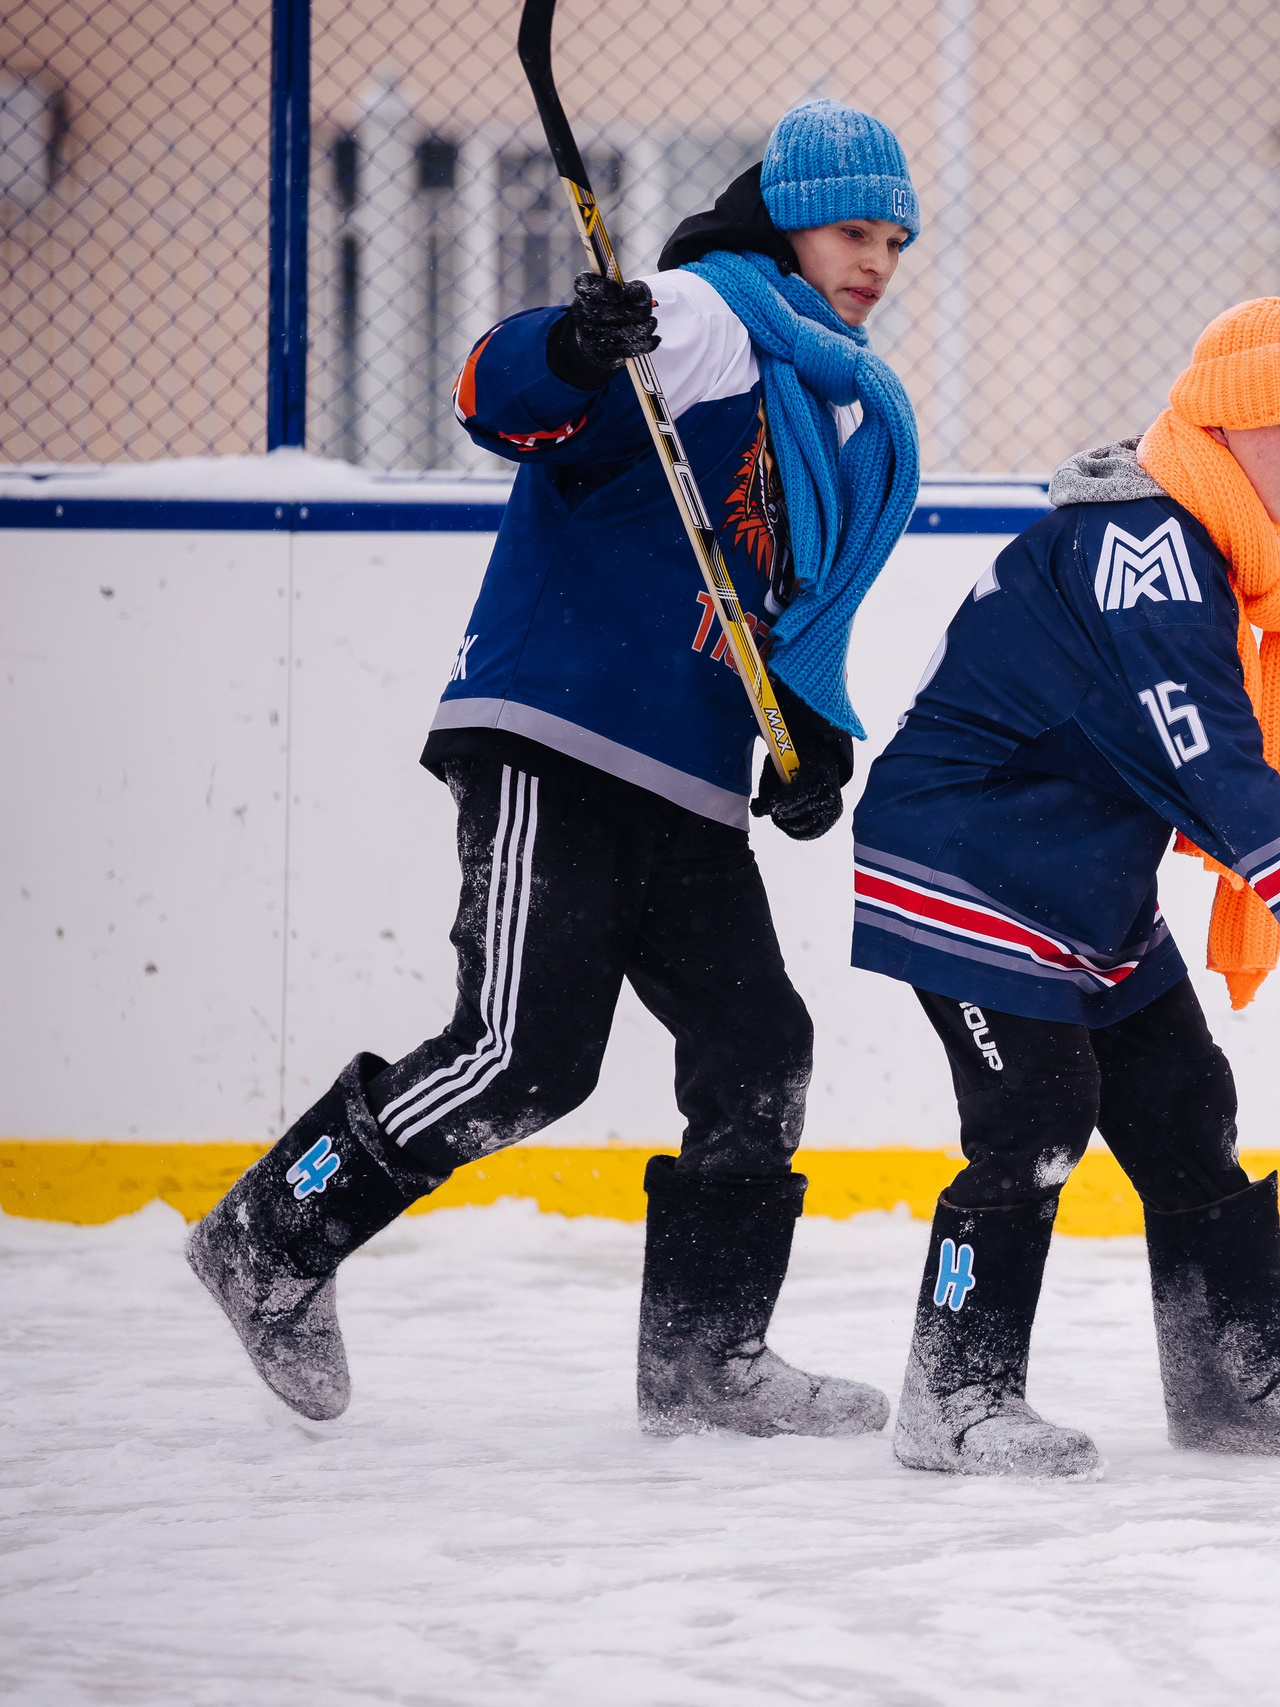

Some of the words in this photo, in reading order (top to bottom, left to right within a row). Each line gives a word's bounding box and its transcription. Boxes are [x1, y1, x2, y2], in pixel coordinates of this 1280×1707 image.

[763, 707, 793, 757] MAX
[1138, 680, 1211, 769] 15
[959, 1002, 1003, 1070] OUP
